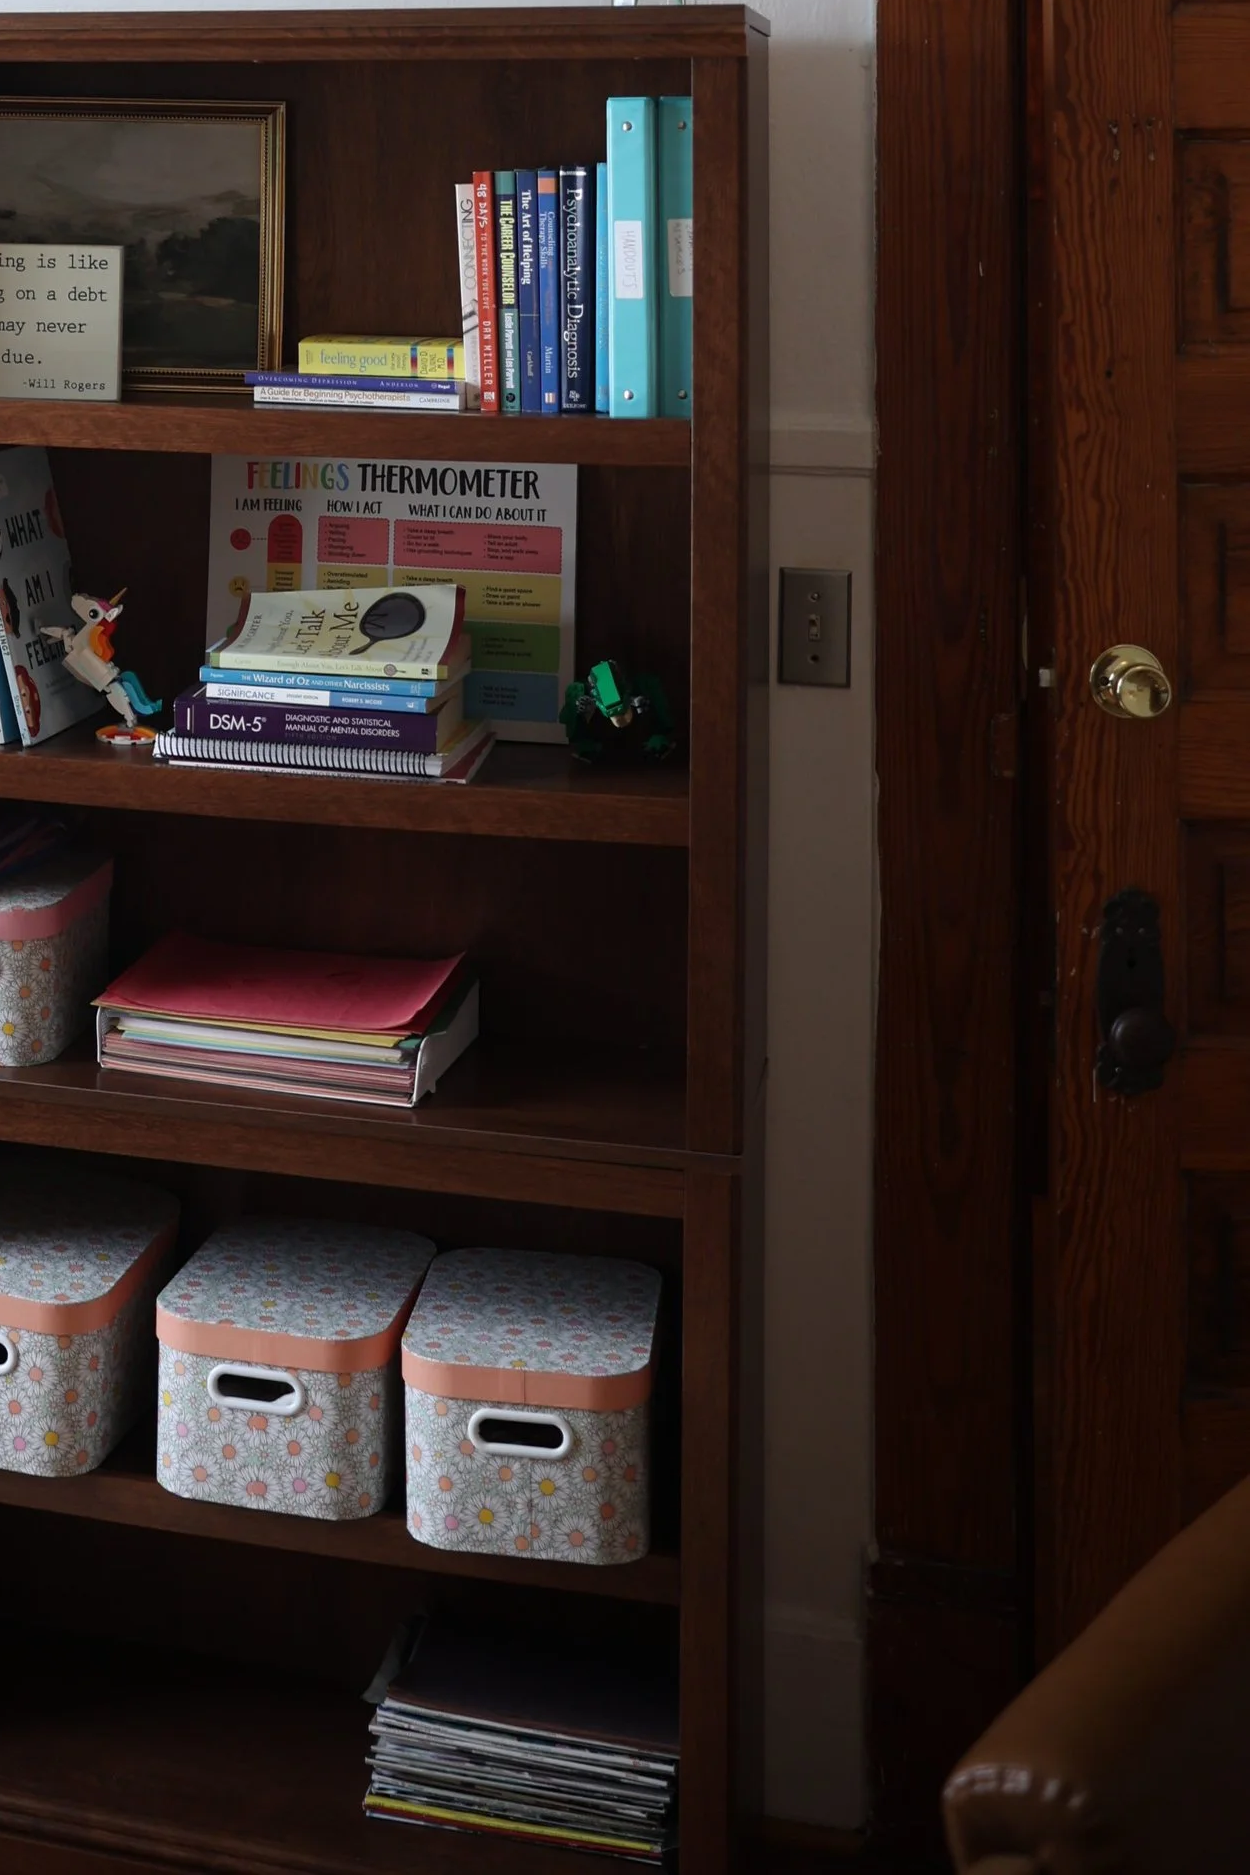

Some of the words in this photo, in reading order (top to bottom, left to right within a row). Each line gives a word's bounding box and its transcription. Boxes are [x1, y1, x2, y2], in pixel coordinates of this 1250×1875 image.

[477, 183, 487, 198] 48
[522, 189, 532, 210] The
[478, 202, 488, 228] DAYS
[500, 200, 513, 216] THE
[522, 212, 532, 228] Art
[538, 212, 548, 244] Therapy
[480, 233, 487, 241] TO
[499, 217, 515, 250] CAREER
[522, 230, 533, 243] of
[547, 211, 555, 256] Counseling
[460, 199, 478, 290] CONNECTING
[563, 188, 583, 300] Psychoanalytic
[38, 254, 56, 269] is
[69, 254, 109, 270] like
[520, 244, 533, 285] Helping
[539, 246, 548, 269] Skills
[621, 231, 637, 290] HANDOUTS
[500, 252, 516, 305] COUNSELOR
[16, 289, 36, 300] on
[47, 289, 57, 300] a
[68, 287, 107, 302] debt
[482, 293, 490, 309] LOVE
[36, 321, 87, 333] never
[482, 320, 491, 339] DAN
[505, 313, 514, 328] Leslie
[504, 328, 514, 349] Parrott
[564, 304, 584, 378] Diagnosis
[1, 349, 42, 365] due.
[320, 350, 356, 367] feeling
[359, 354, 387, 372] good
[483, 345, 493, 385] MILLER
[505, 358, 514, 367] Les
[544, 346, 554, 374] Martin
[23, 379, 56, 389] -Will
[64, 380, 106, 392] Rogers
[505, 368, 515, 388] Parrott
[268, 388, 290, 396] Guide
[291, 388, 302, 397] for
[304, 389, 343, 400] Beginning
[345, 390, 411, 402] Psychotherapists
[246, 461, 349, 492] FEELINGS
[357, 463, 540, 499] THERMOMETER
[241, 499, 262, 511] AM
[263, 499, 303, 512] FEELING
[327, 499, 354, 513] HOW
[362, 501, 382, 514] ACT
[408, 504, 440, 518] WHAT
[449, 506, 472, 520] CAN
[475, 508, 492, 520] DO
[495, 508, 535, 522] ABOUT
[537, 509, 547, 523] IT
[5, 508, 46, 549] WHAT
[25, 573, 44, 606] AM
[45, 570, 55, 598] I
[295, 609, 326, 639] Talk
[329, 602, 359, 631] Me
[253, 673, 284, 684] Wizard
[286, 675, 295, 684] of
[296, 676, 310, 685] Oz
[344, 680, 390, 691] Narcissists
[285, 713, 330, 724] DIAGNOSTIC
[332, 716, 349, 725] AND
[351, 716, 391, 727] STATISTICAL
[285, 724, 316, 733] MANUAL
[330, 725, 359, 735] MENTAL
[360, 728, 400, 737] DISORDERS
